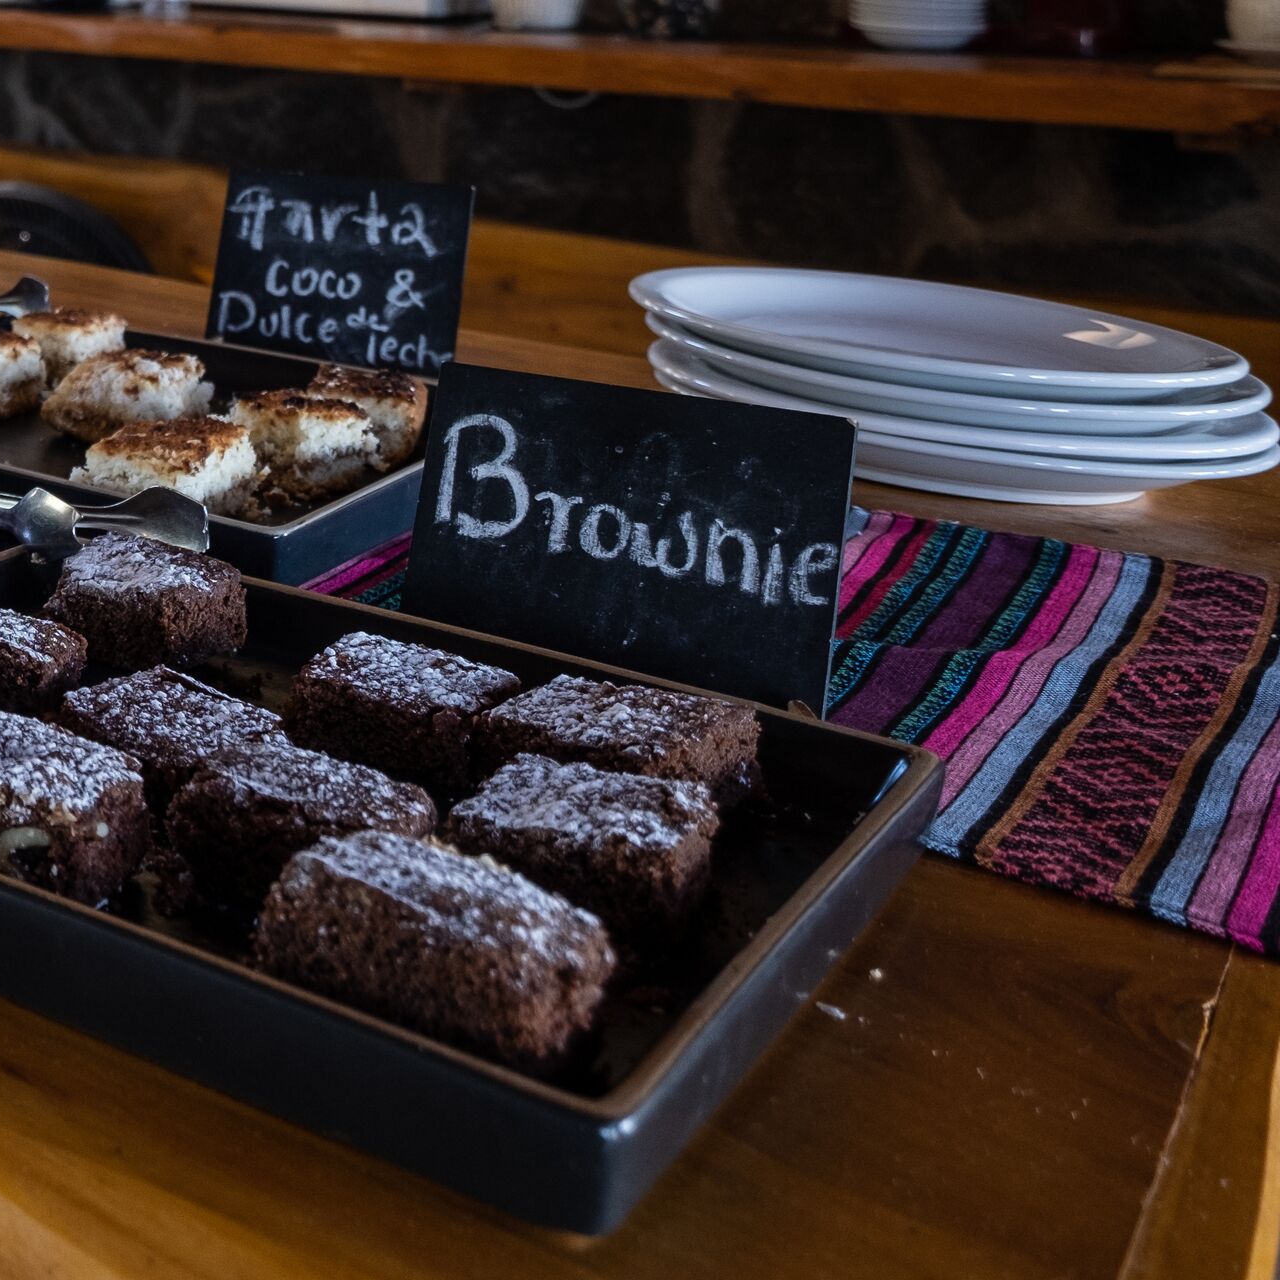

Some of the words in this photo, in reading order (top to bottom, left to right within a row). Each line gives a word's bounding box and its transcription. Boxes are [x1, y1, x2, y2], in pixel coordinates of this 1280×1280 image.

[226, 185, 439, 258] Tarta
[217, 291, 338, 344] Dulce
[346, 306, 390, 332] de
[386, 269, 425, 310] &
[434, 412, 838, 608] Brownie
